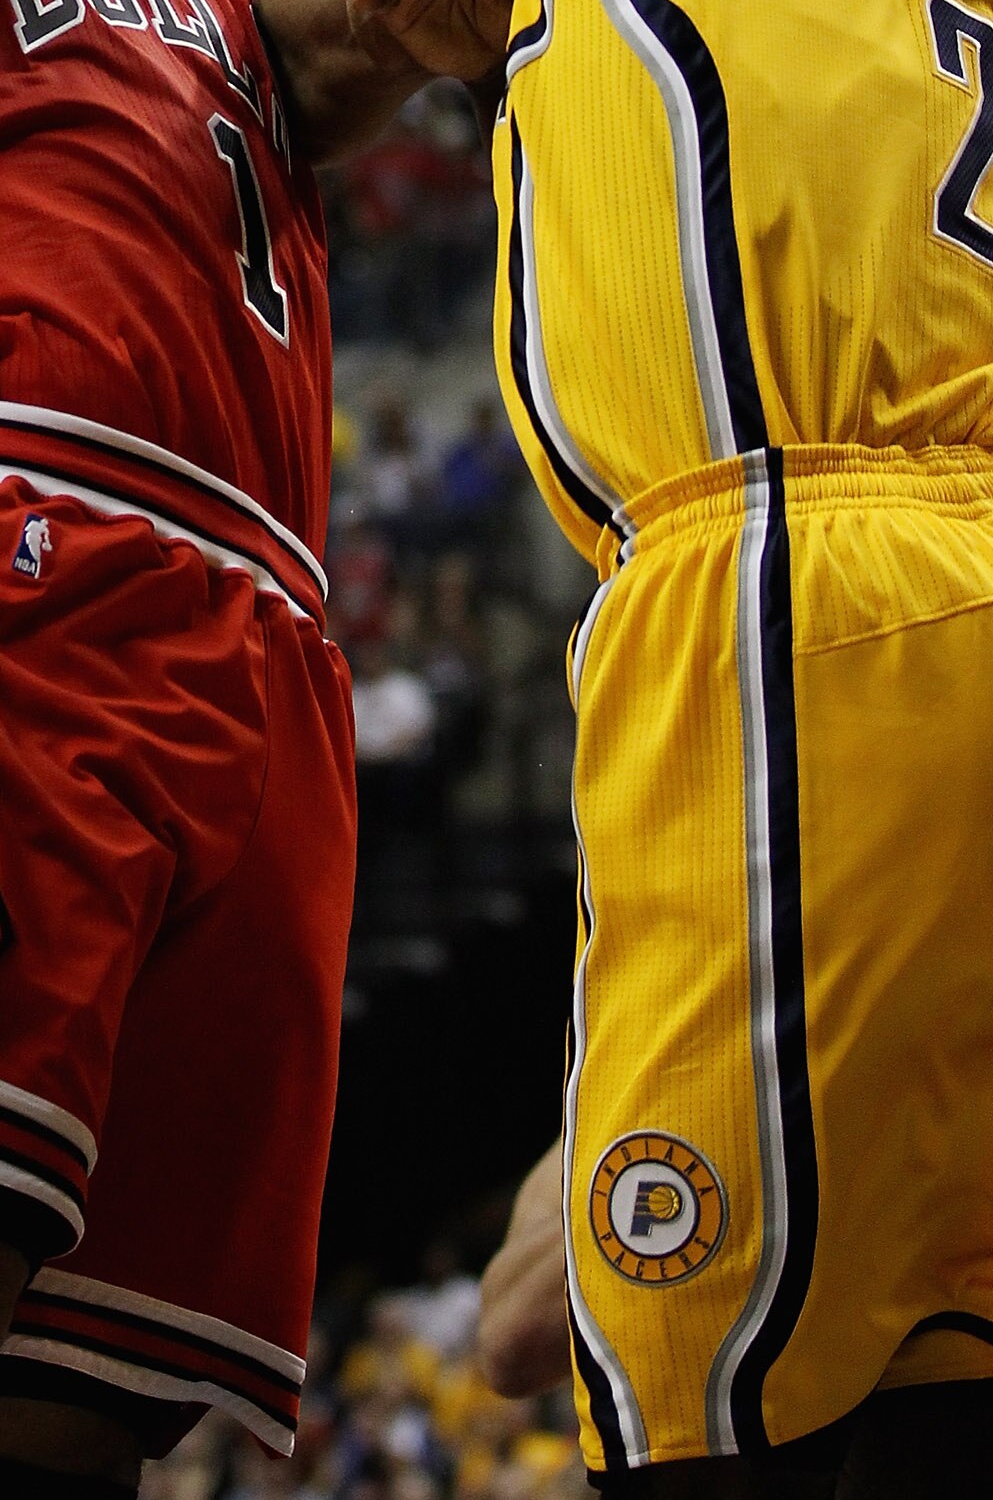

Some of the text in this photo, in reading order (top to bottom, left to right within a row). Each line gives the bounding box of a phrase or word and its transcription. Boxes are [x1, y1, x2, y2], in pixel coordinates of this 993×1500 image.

[207, 112, 289, 351] 1
[15, 557, 36, 574] NBA
[594, 1138, 715, 1198] INDIANA
[599, 1231, 711, 1280] PACERS
